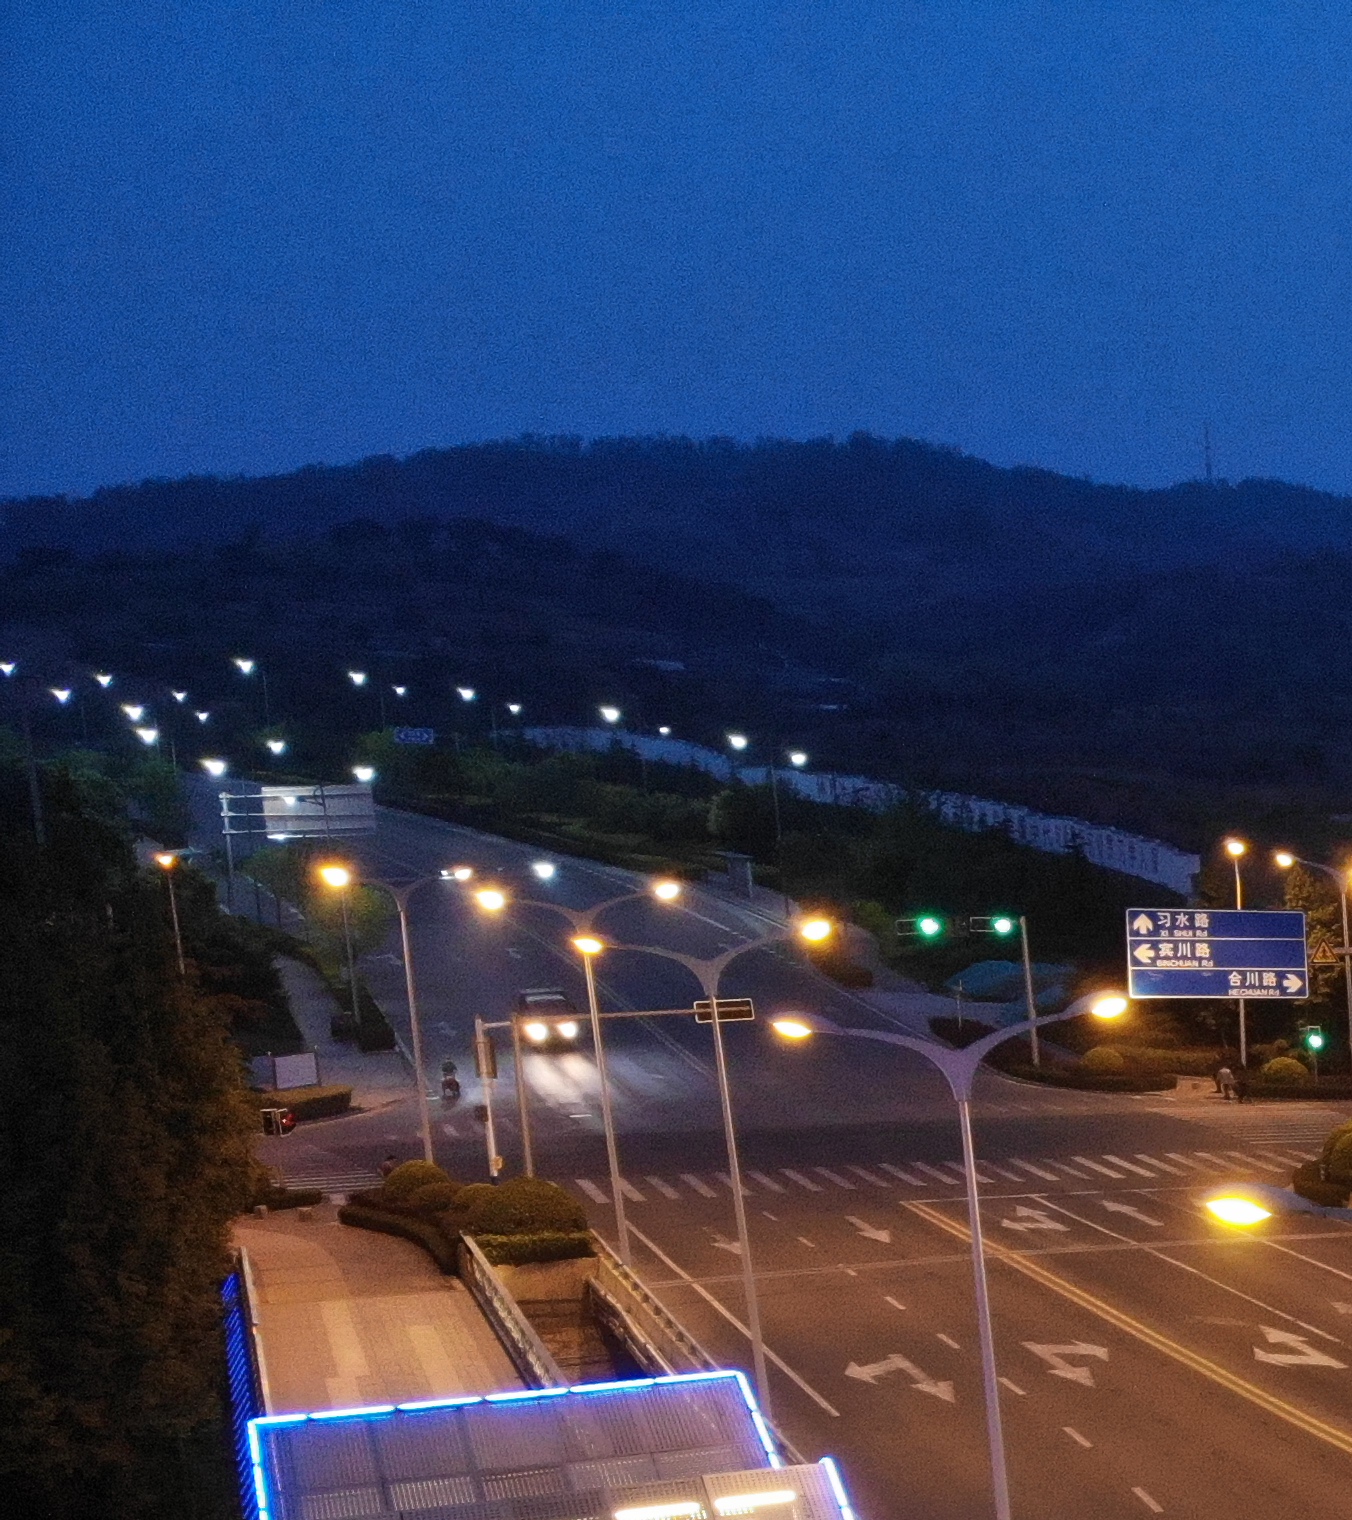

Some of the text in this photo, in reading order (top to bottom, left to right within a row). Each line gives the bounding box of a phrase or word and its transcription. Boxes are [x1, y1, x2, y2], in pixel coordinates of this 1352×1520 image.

[1157, 912, 1209, 928] 习水路
[1158, 942, 1210, 958] 宾川路
[1228, 970, 1277, 987] 合川路
